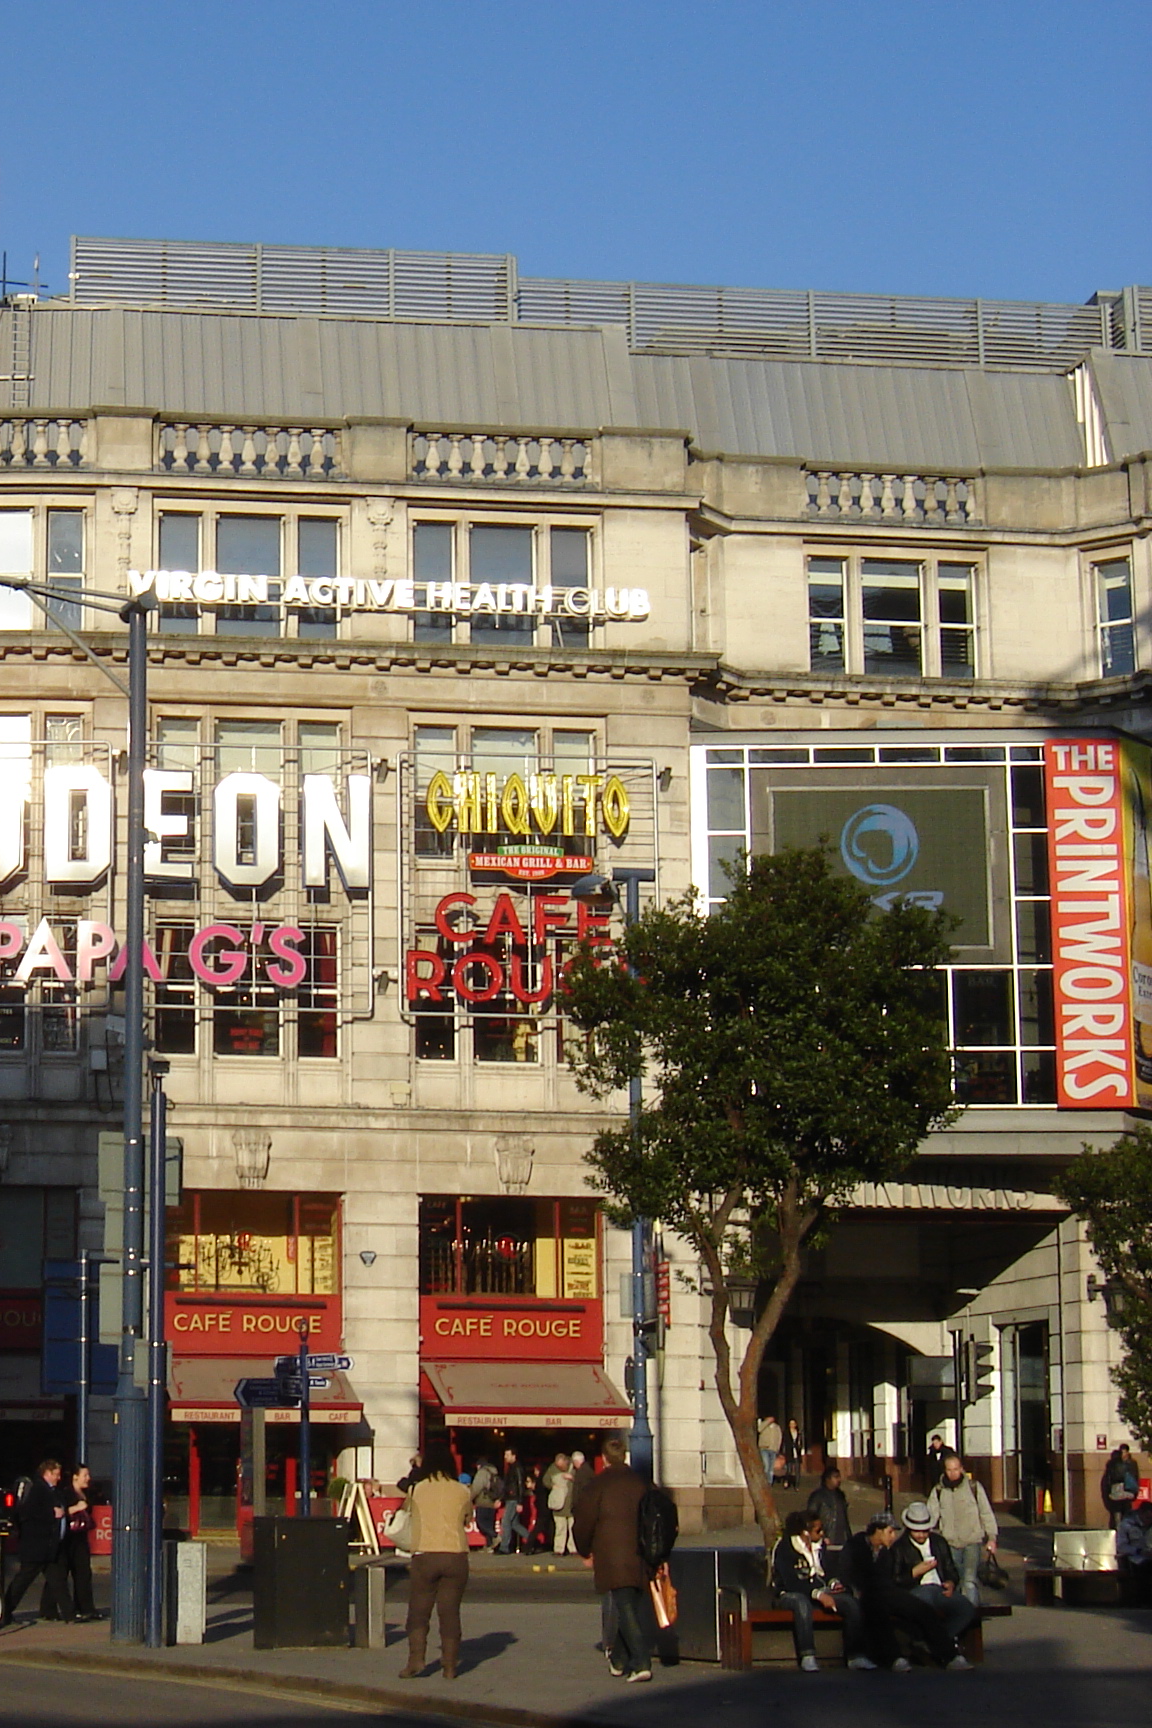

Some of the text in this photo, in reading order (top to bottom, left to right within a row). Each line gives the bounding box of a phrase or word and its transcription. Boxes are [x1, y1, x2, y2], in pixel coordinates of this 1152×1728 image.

[127, 570, 651, 617] VIRGIN ACTIVE HEALTH CLUB
[427, 771, 630, 837] CHIQUITO
[475, 856, 586, 869] MEXICAN GRILL & BAR
[1051, 745, 1128, 1101] THE PRINTWORKS
[188, 923, 307, 988] G'S
[174, 1310, 322, 1333] CAFÉ ROUGE
[435, 1315, 582, 1338] CAFÉ ROUGE
[183, 1412, 235, 1420] RESTAURANT
[457, 1417, 507, 1425] RESTAURANT
[545, 1418, 562, 1426] BAR
